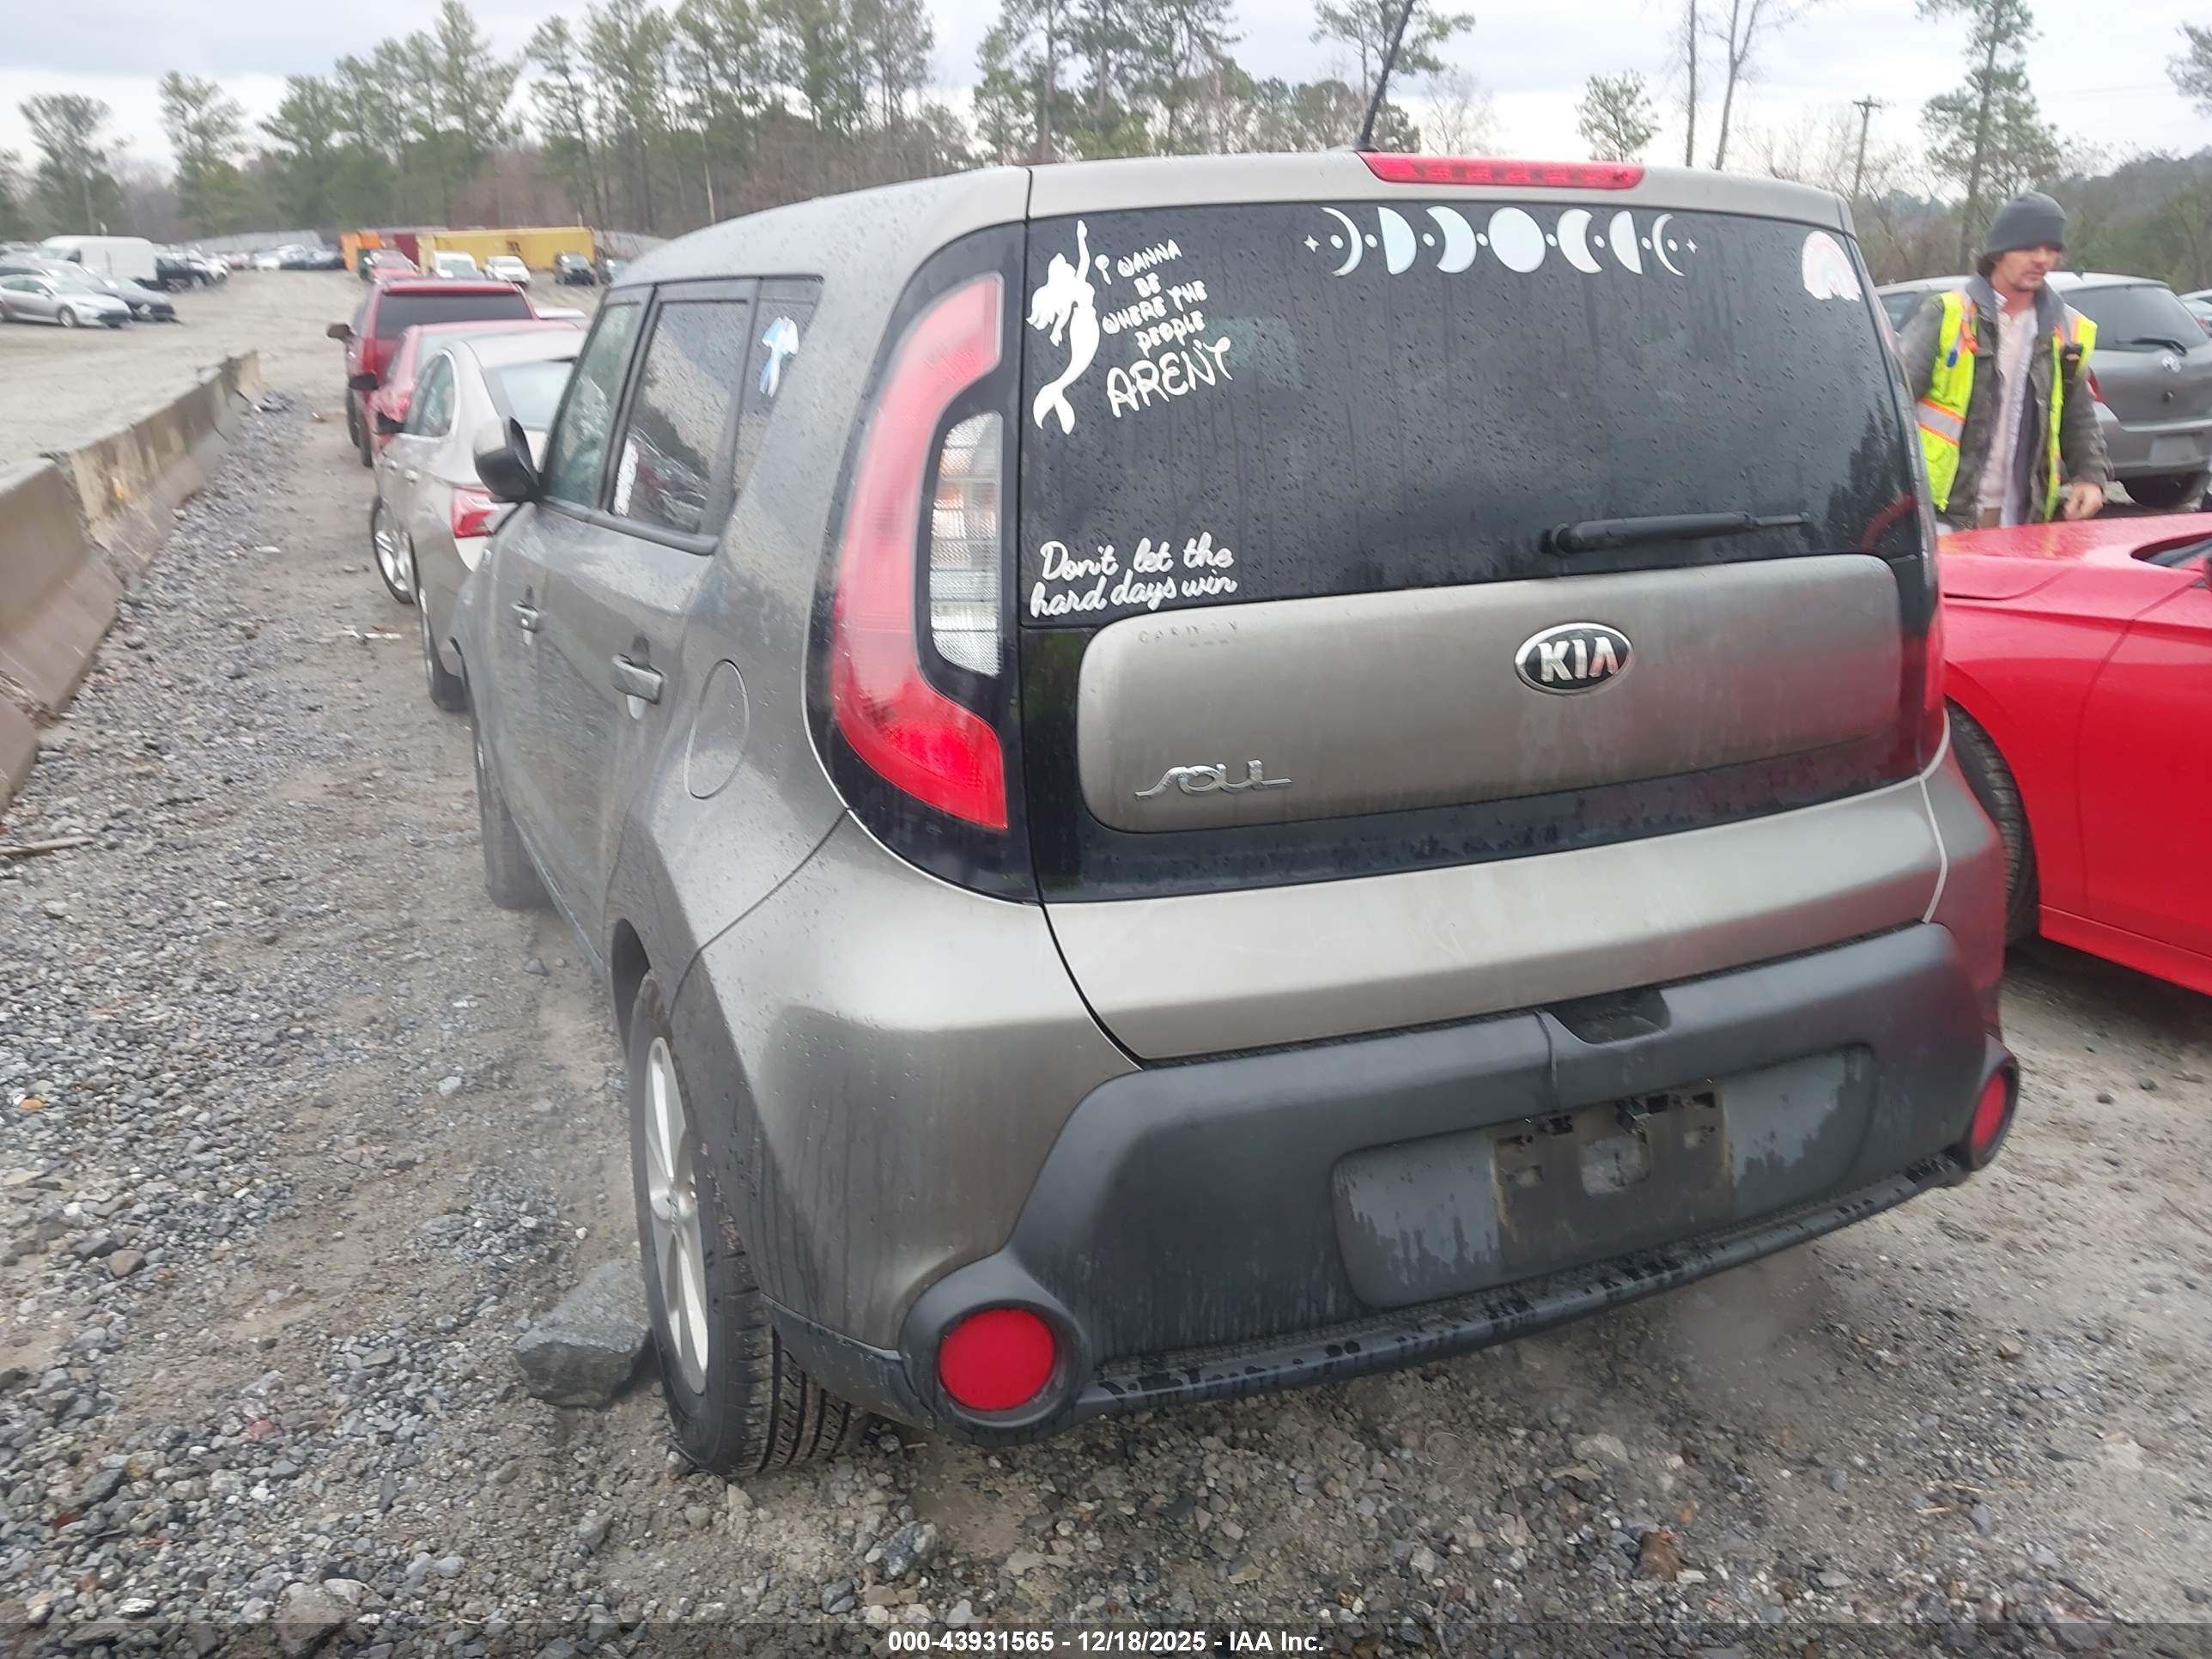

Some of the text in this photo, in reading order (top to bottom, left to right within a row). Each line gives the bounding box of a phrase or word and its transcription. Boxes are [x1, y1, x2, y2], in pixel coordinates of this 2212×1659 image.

[1117, 239, 1182, 277] WANNA
[1102, 280, 1208, 334] WHERE THE
[1133, 272, 1161, 298] BE
[1134, 310, 1206, 358] PEOPLE
[1039, 532, 1234, 580] Don't let the
[1030, 569, 1238, 618] hard days win
[1537, 636, 1620, 682] KIA
